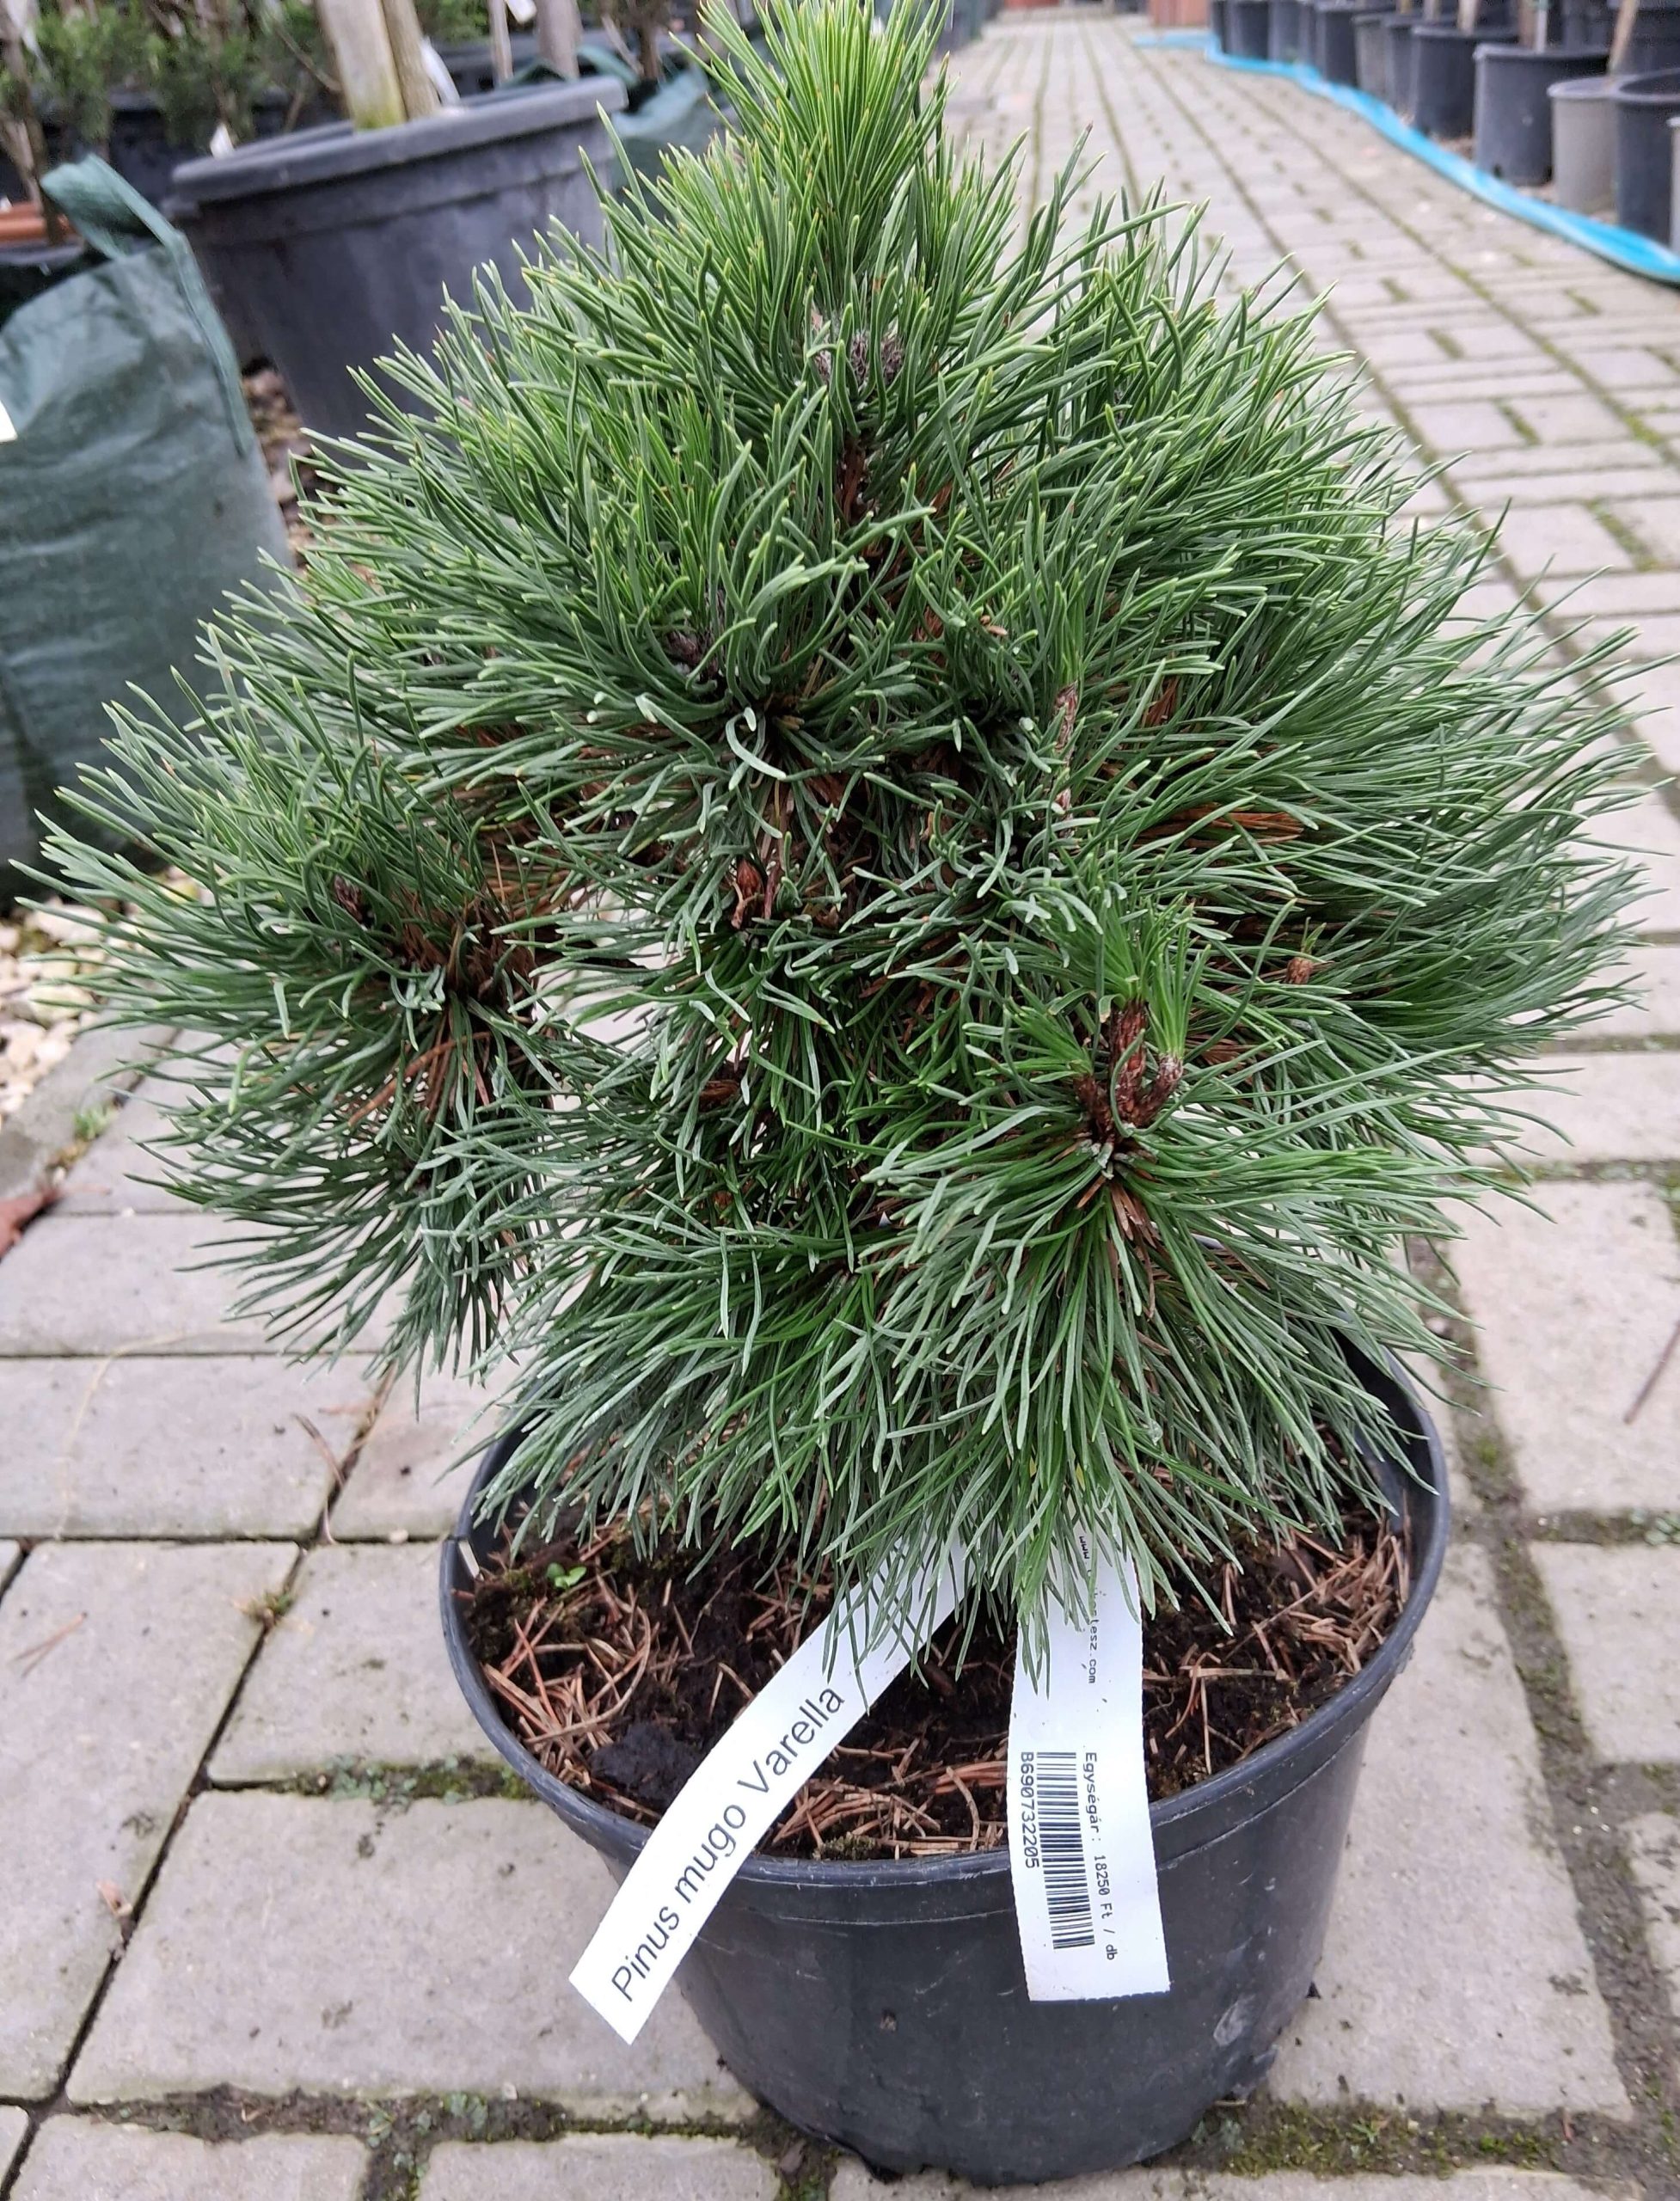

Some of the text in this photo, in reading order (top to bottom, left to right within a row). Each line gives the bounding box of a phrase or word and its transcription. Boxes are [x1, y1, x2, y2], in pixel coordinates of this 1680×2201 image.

[1079, 1536, 1100, 1683] www.krtesz.com
[1021, 1751, 1039, 1869] B690732205
[1083, 1752, 1101, 1842] Egységár:
[610, 1688, 845, 2002] Pinus mugo Varella
[1094, 1855, 1111, 1896] 18250
[1101, 1903, 1113, 1919] Ft
[1106, 1943, 1118, 1960] db
